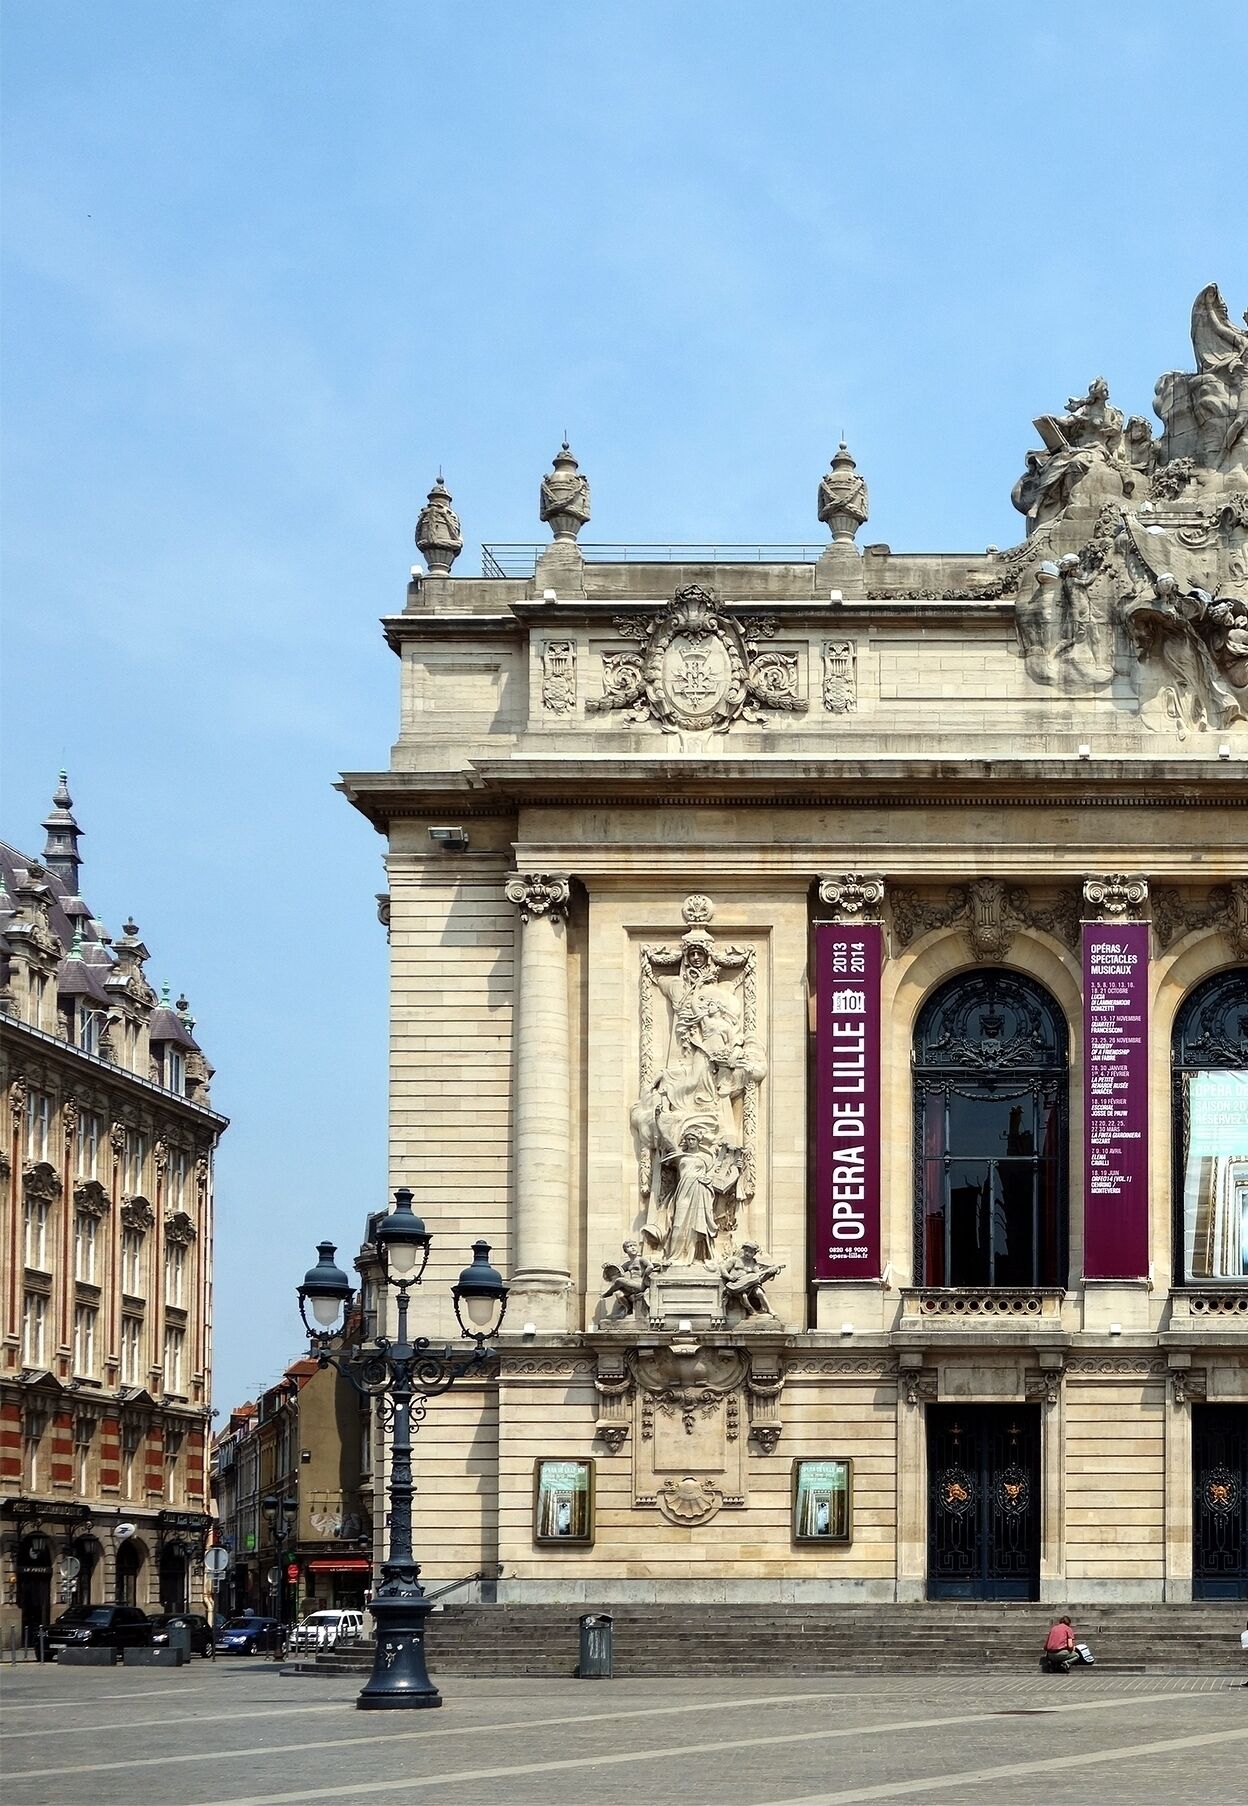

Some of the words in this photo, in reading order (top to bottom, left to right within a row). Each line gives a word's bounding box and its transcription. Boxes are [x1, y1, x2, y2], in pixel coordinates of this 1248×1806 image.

[833, 942, 847, 972] 2013
[851, 942, 864, 972] 2014
[1091, 942, 1121, 954] OPÉRAS
[1091, 954, 1138, 964] SPECTACLES
[1091, 965, 1131, 975] MUSICAUX
[842, 996, 861, 1010] 10!
[833, 1023, 864, 1092] LILLE
[1195, 1100, 1230, 1111] SAISON
[833, 1103, 864, 1136] DE
[833, 1146, 864, 1239] OPERA
